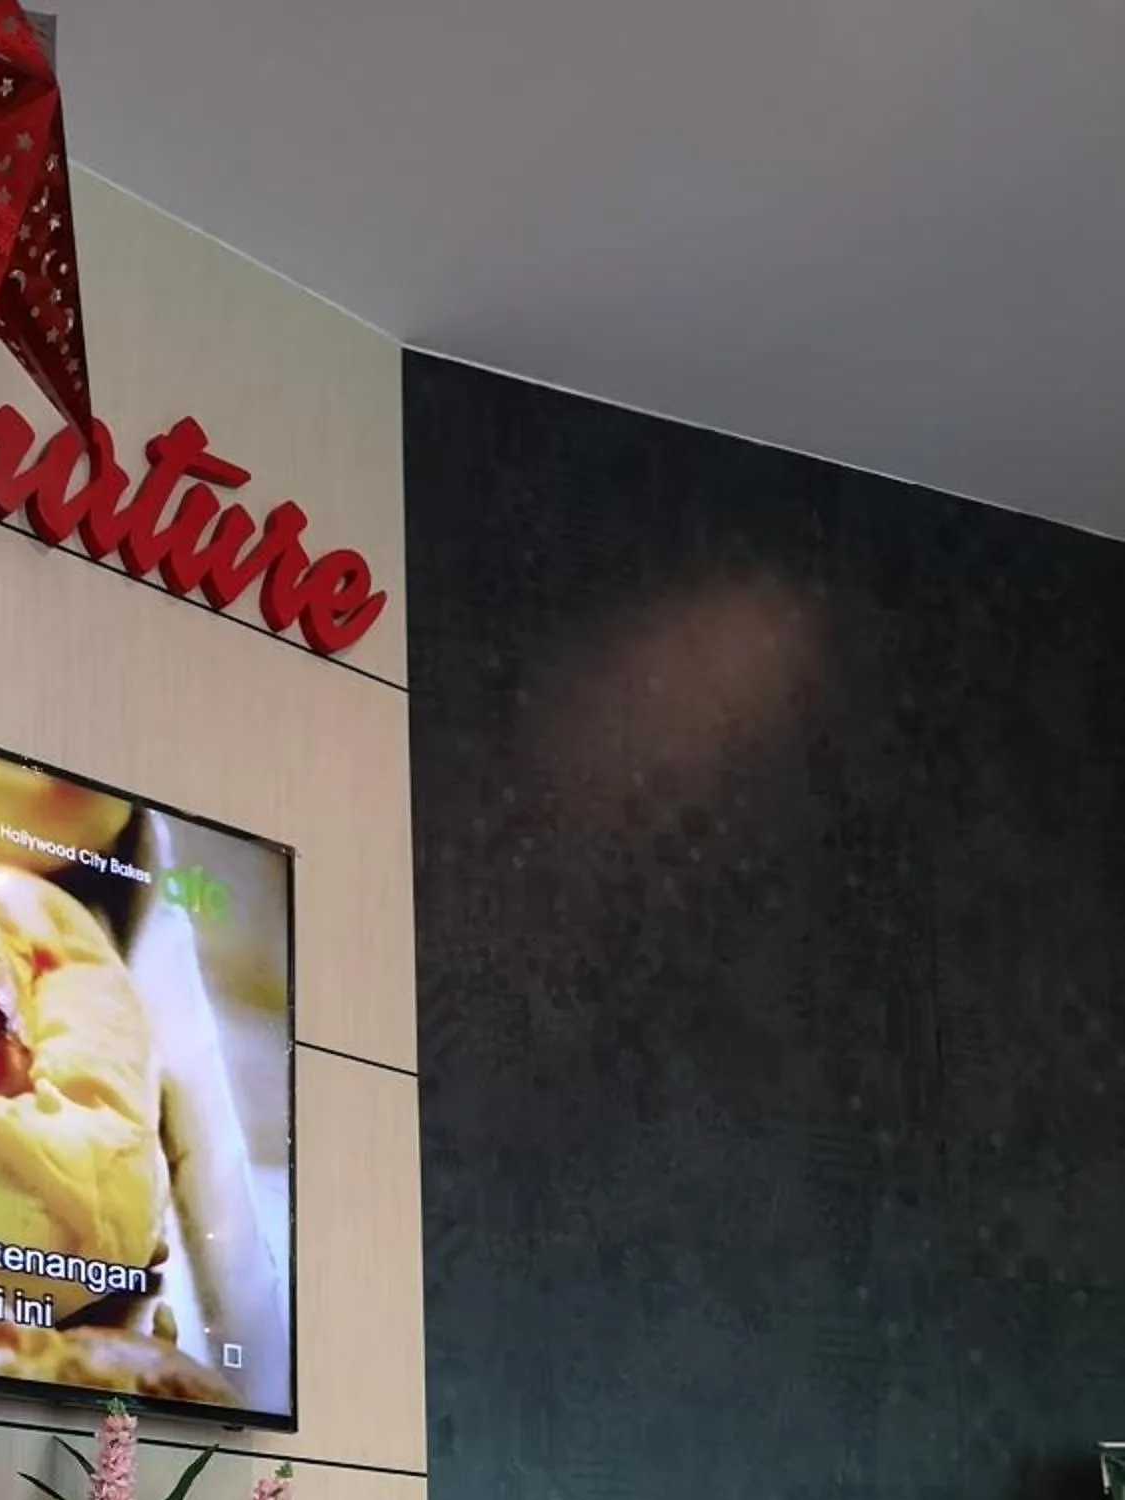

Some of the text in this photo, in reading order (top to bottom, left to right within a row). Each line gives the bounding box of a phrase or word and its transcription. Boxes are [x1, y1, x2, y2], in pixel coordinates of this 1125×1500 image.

[0, 823, 76, 861] Hollywood
[78, 849, 108, 873] City
[110, 858, 152, 884] Bakes
[15, 1290, 53, 1327] ini
